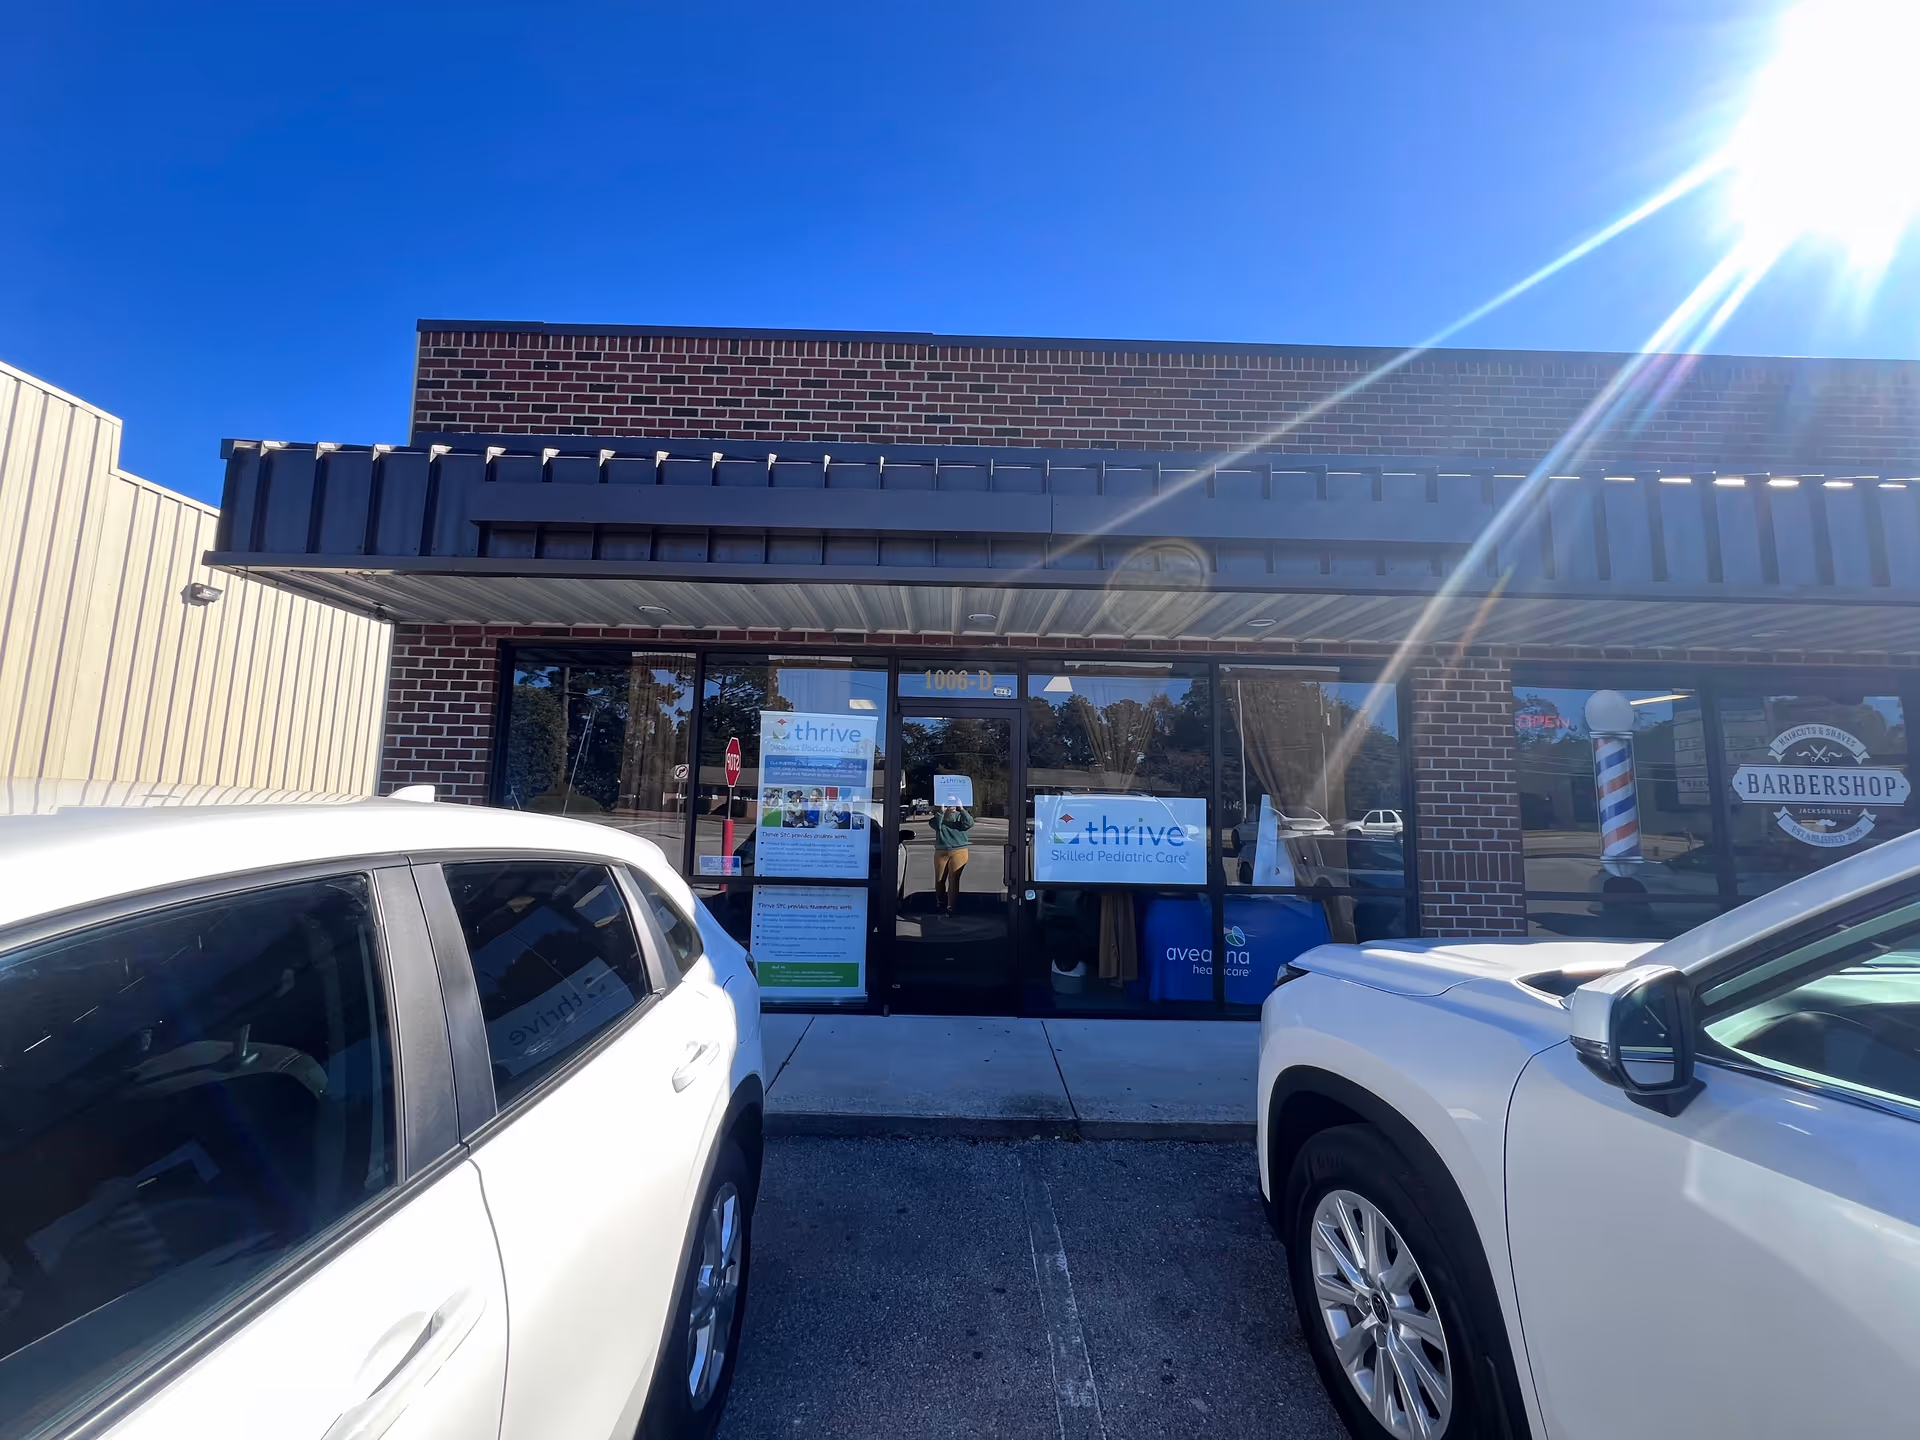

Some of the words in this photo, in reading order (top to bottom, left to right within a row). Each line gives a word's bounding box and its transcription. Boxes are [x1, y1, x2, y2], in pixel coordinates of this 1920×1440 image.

[925, 669, 993, 691] 1006-D
[794, 720, 861, 743] thrive
[1517, 714, 1571, 729] OPEN
[1778, 726, 1817, 746] HAIRCUTS
[1825, 728, 1858, 748] SHAVES
[1747, 773, 1897, 797] BARBERSHOP
[1085, 815, 1185, 847] thrive
[1791, 825, 1846, 844] ESTABLISHED
[1051, 850, 1094, 862] Skilled
[1098, 851, 1153, 863] Pediatric
[1166, 947, 1250, 965] aveana
[1193, 964, 1250, 977] heacare
